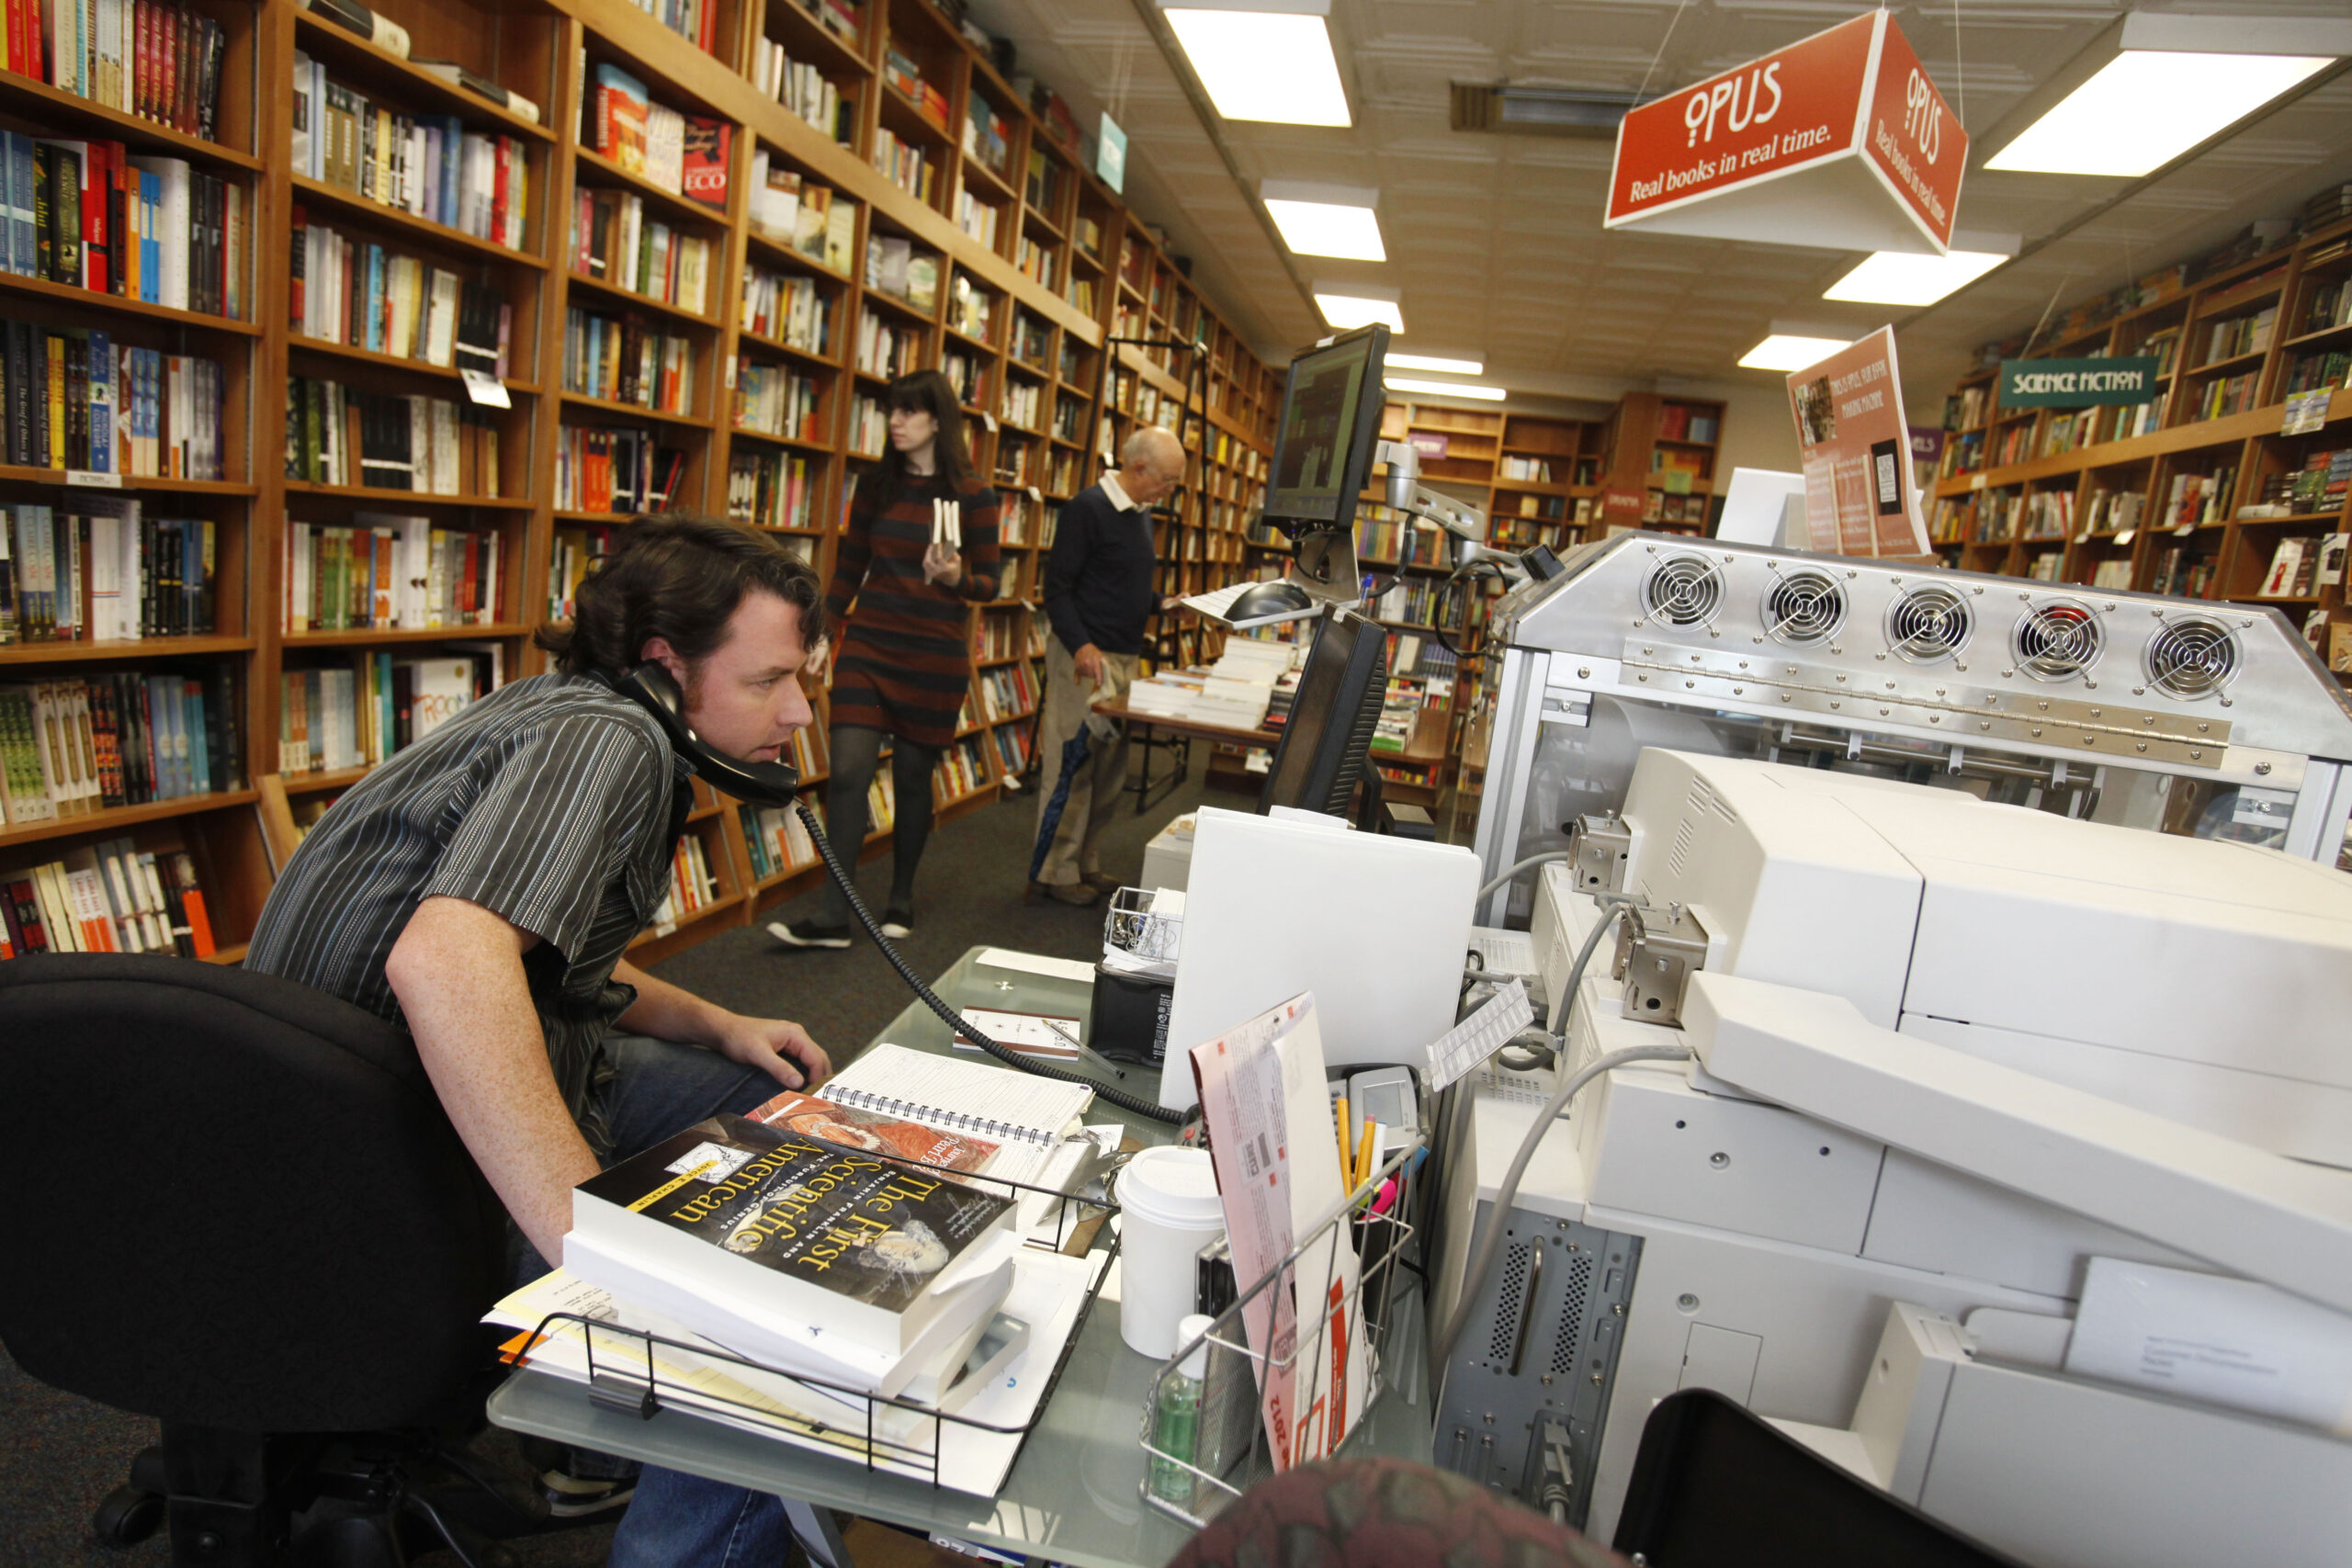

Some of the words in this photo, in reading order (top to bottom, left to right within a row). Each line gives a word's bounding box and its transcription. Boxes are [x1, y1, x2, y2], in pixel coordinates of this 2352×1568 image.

[1684, 62, 1781, 148] OPUS
[1905, 68, 1942, 165] OPUS
[1630, 175, 1663, 203] Real
[1667, 159, 1715, 192] books
[1719, 152, 1737, 174] in
[1741, 137, 1777, 169] real
[1781, 123, 1832, 154] time.
[1875, 118, 1894, 159] Real
[1891, 139, 1913, 184] books
[1910, 166, 1919, 194] in
[1917, 182, 1933, 209] real
[684, 173, 726, 191] ECO
[2012, 373, 2077, 394] SCIENCE
[2079, 371, 2143, 392] FICTION
[816, 1153, 834, 1163] THE
[928, 1136, 959, 1161] Pearl
[670, 1137, 825, 1223] American
[687, 1162, 710, 1177] JOYCE
[777, 1163, 817, 1190] PURSUIT
[854, 1169, 897, 1201] BENJAMIN
[637, 1184, 675, 1206] CHAPLIN
[736, 1156, 882, 1247] Scientific
[762, 1190, 775, 1202] OF
[865, 1175, 943, 1213] The
[720, 1202, 760, 1231] GENIUS
[806, 1201, 854, 1240] FRANKLIN
[783, 1241, 804, 1258] AND
[797, 1213, 892, 1271] First
[1270, 1394, 1286, 1446] 2012
